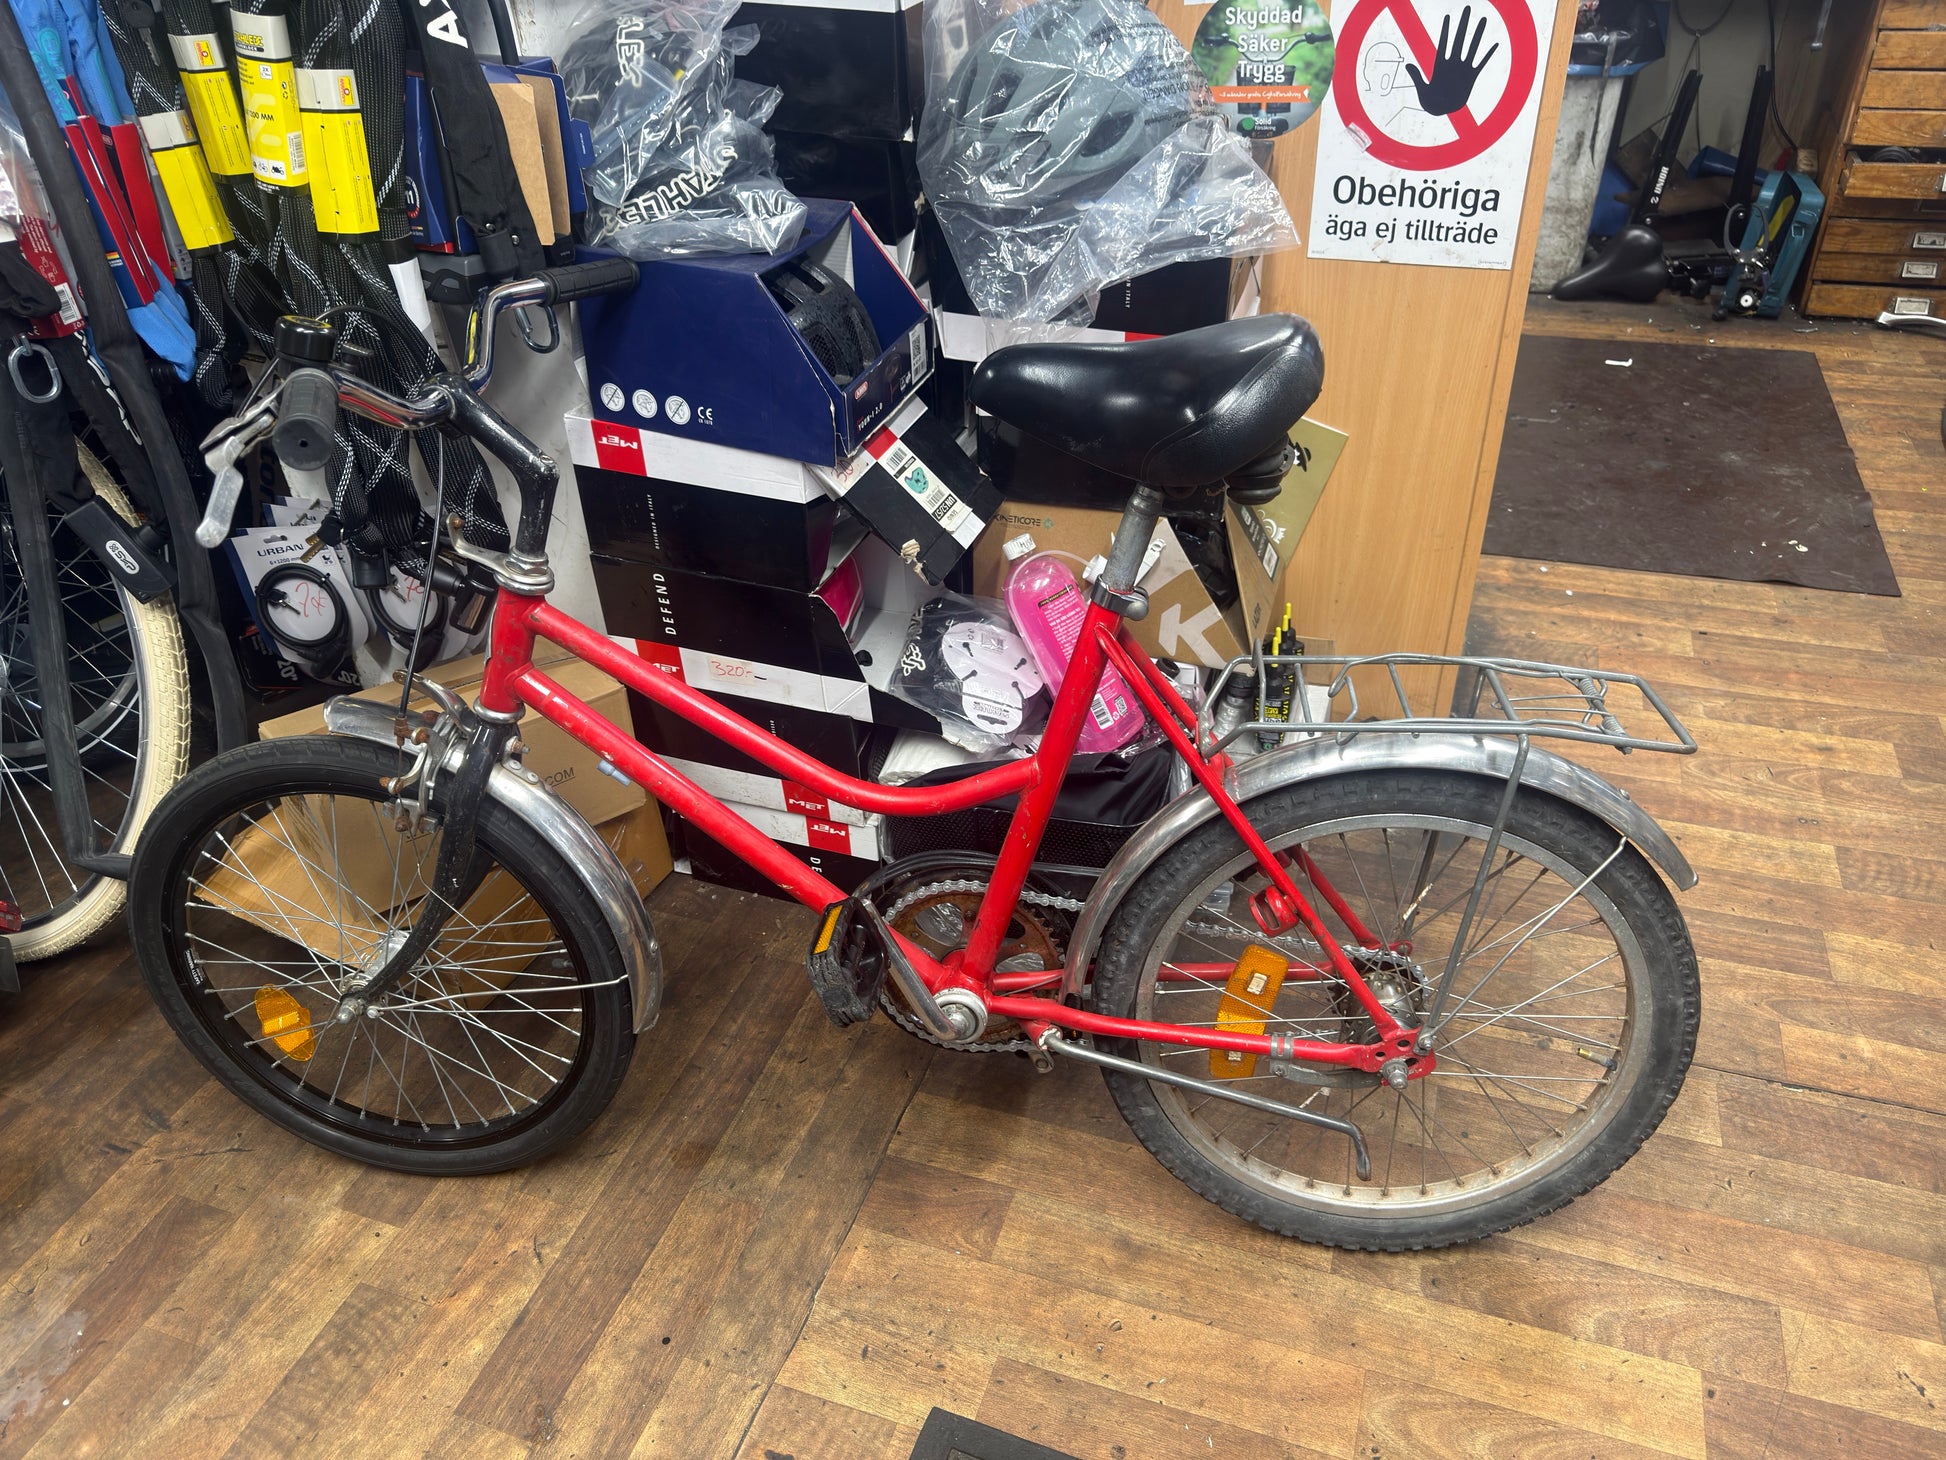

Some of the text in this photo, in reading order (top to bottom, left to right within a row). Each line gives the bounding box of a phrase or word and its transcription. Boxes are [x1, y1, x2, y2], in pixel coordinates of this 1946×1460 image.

[1225, 5, 1303, 30] Skyddad
[1237, 33, 1288, 53] Säker
[1238, 60, 1285, 83] Trygg
[1255, 117, 1272, 126] Solid
[1655, 165, 1670, 196] UNIOR
[1332, 174, 1500, 216] Obehöriga
[1325, 215, 1499, 245] äga ej tillträde
[697, 406, 713, 420] CE
[598, 434, 639, 451] MET
[944, 496, 955, 506] UN
[994, 514, 1041, 527] KINETICORE
[257, 544, 304, 556] URBAN
[653, 571, 678, 636] DEFEND
[788, 798, 825, 811] MET
[811, 823, 846, 837] MET
